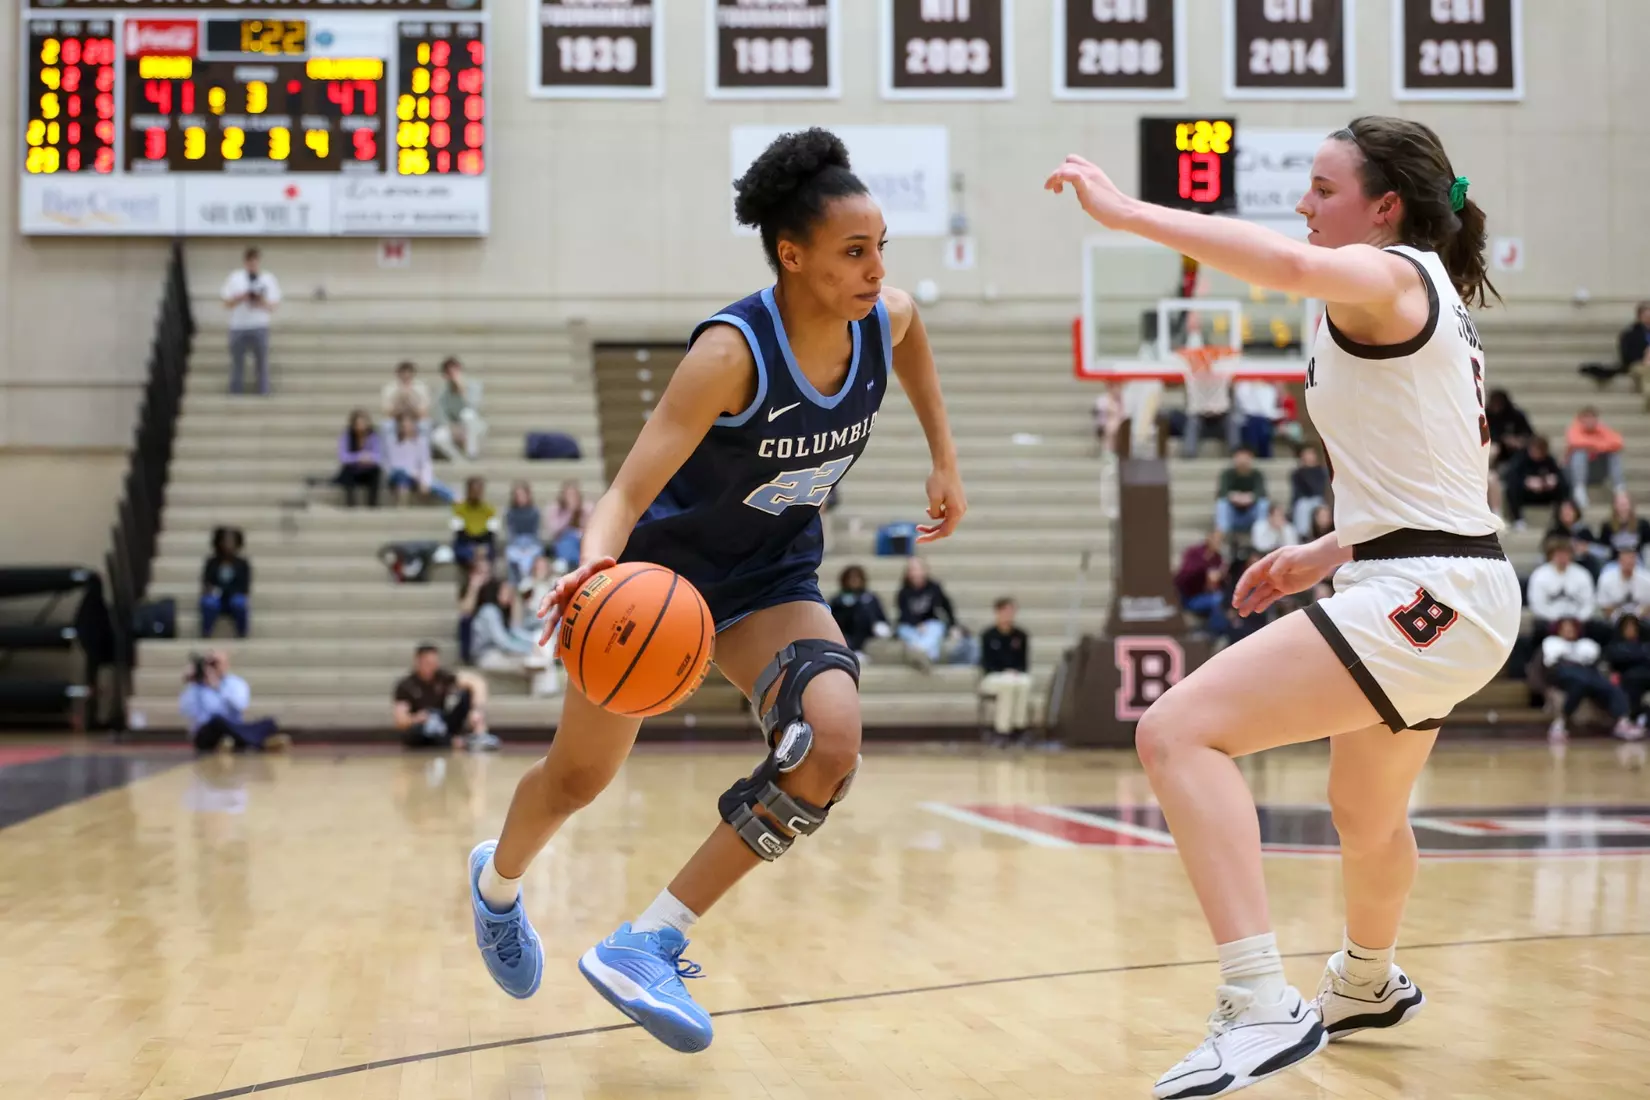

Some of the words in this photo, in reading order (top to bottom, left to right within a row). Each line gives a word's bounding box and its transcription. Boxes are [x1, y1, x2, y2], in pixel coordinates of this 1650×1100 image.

[241, 20, 307, 55] 1:22
[557, 36, 637, 72] 1939
[906, 38, 990, 74] 2003
[1249, 38, 1329, 74] 2014
[1419, 39, 1497, 75] 2019
[145, 80, 195, 114] 41
[246, 80, 267, 113] 3
[327, 80, 377, 116] 47
[1178, 152, 1221, 202] 13
[757, 411, 877, 459] COLUMBIA
[742, 454, 854, 516] 22
[561, 574, 609, 650] ELITE
[1387, 586, 1459, 649] B
[1114, 635, 1185, 721] B
